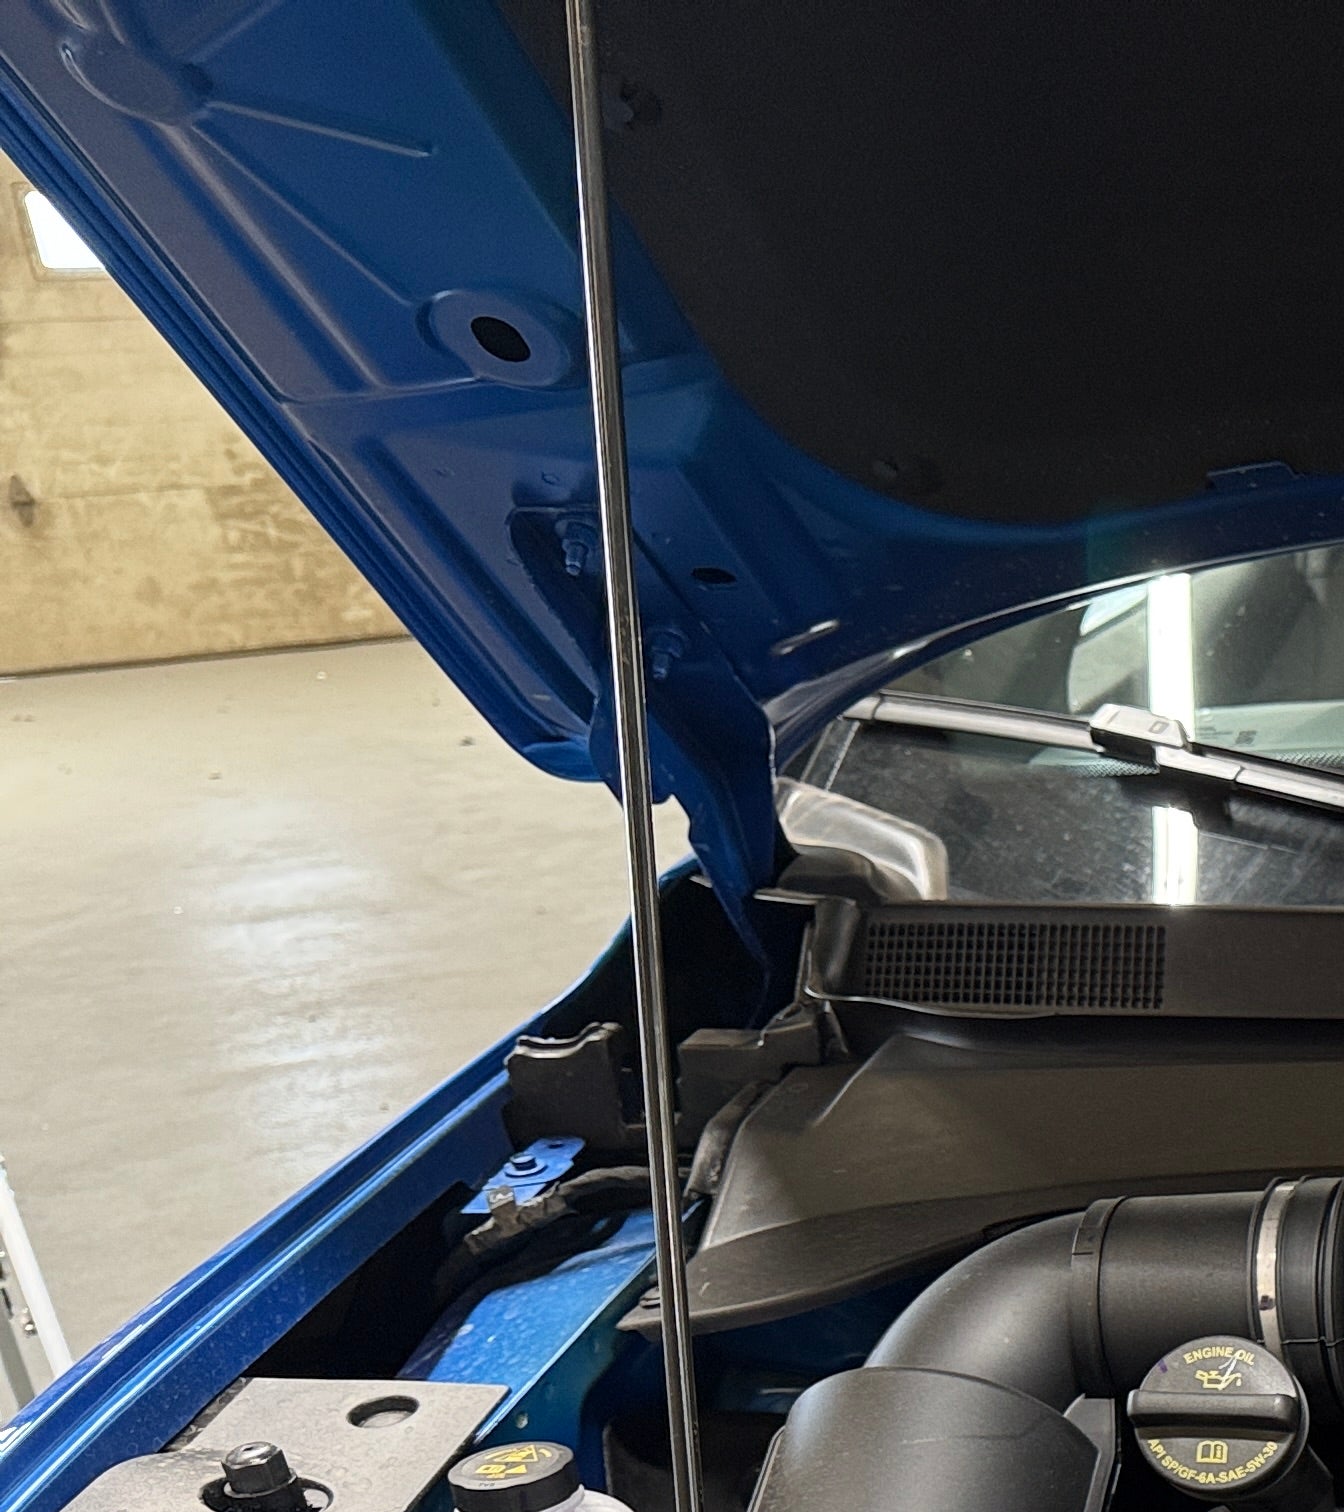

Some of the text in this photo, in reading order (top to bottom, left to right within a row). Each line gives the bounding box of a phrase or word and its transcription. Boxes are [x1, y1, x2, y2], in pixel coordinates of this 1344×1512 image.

[1183, 1346, 1256, 1366] ENGINE OIL
[1147, 1439, 1165, 1459] API
